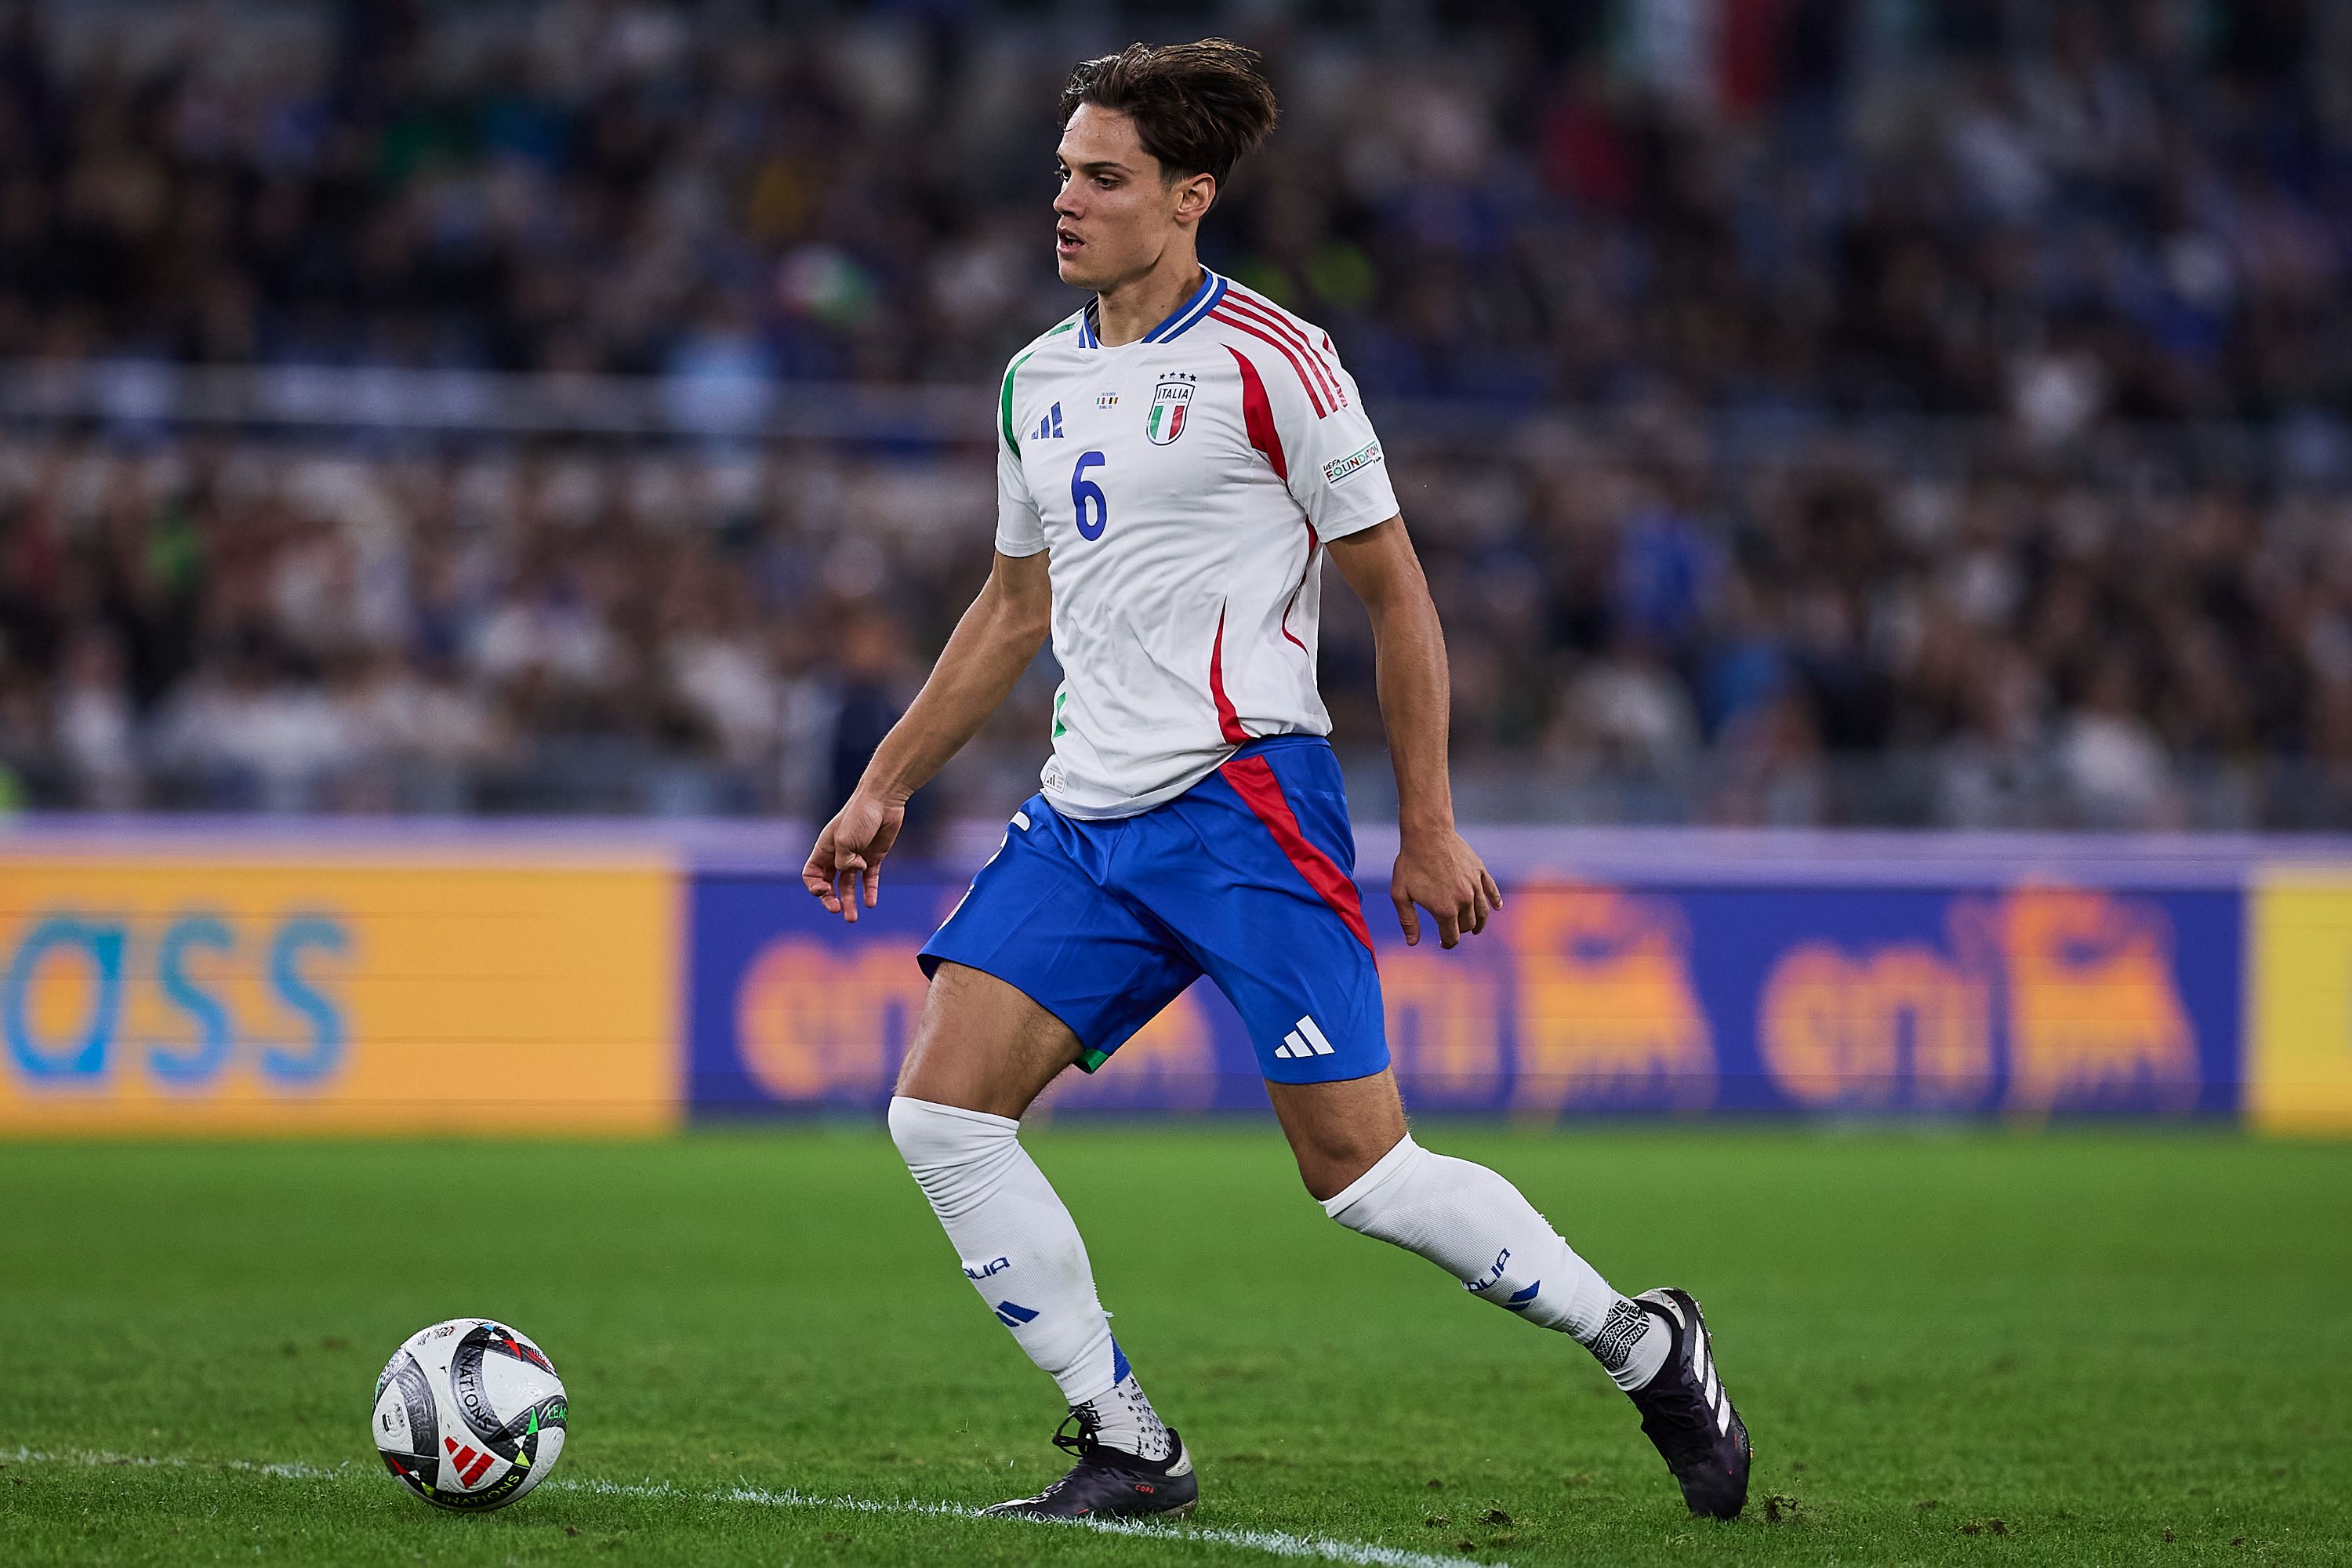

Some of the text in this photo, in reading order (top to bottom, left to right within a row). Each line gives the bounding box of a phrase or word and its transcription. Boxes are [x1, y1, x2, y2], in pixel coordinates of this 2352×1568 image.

[1158, 388, 1189, 400] ITALIA
[1323, 459, 1341, 472] UEFA
[1326, 444, 1380, 481] FOUNDATION
[1072, 451, 1107, 541] 6
[459, 1355, 492, 1429] NATIONS
[447, 1475, 520, 1505] NATIONS
[1134, 1484, 1154, 1494] COPA
